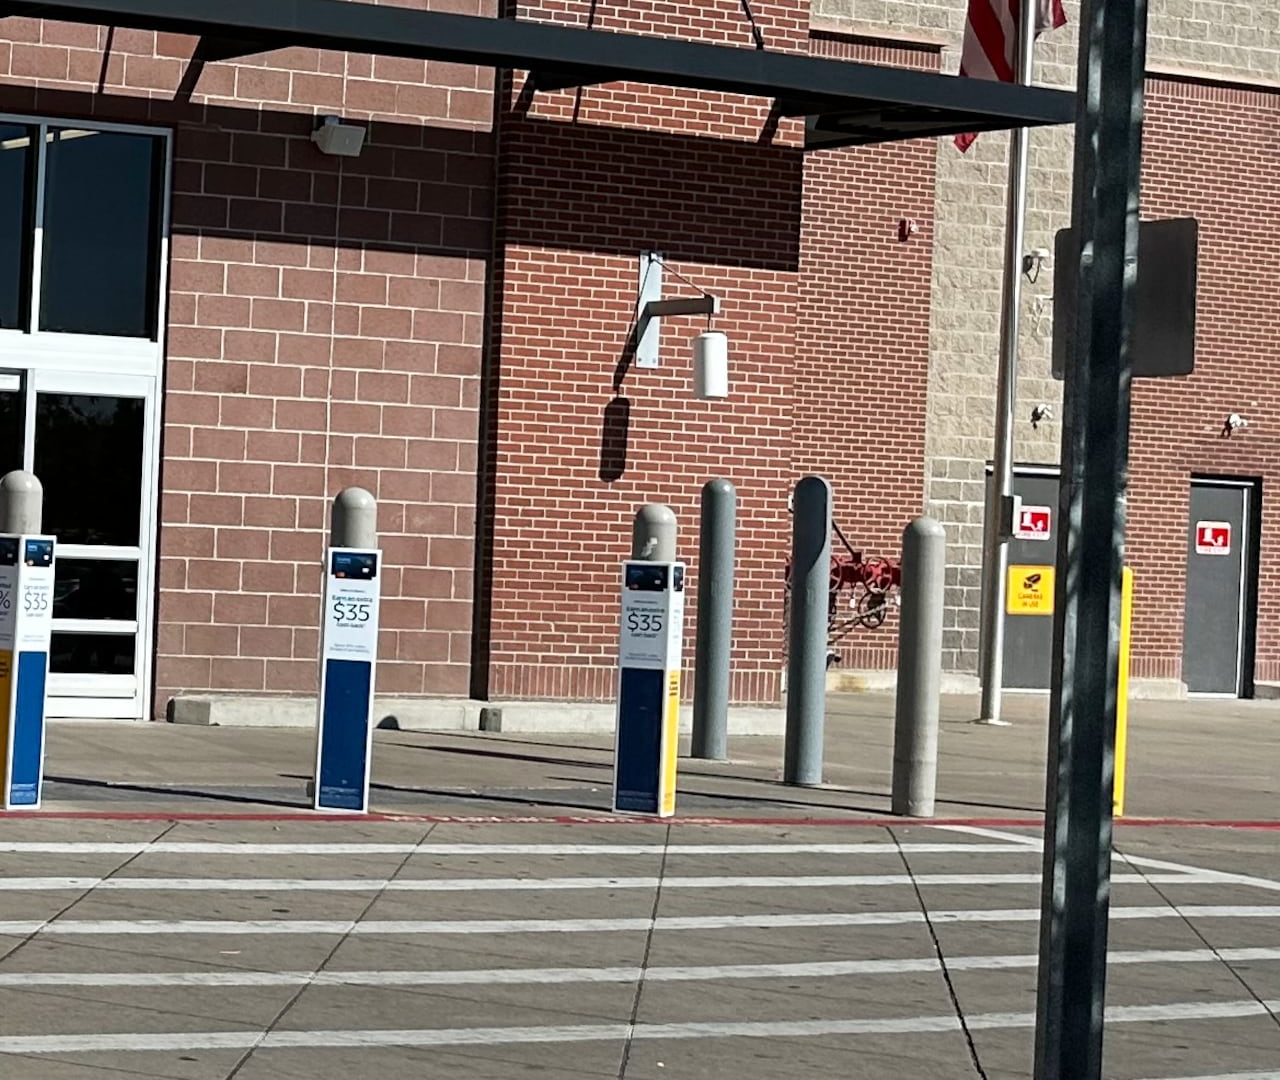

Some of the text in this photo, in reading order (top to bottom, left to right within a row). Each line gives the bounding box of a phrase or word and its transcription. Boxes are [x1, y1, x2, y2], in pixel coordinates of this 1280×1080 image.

[24, 590, 48, 612] $35
[332, 600, 371, 623] $35
[626, 610, 663, 633] $35
